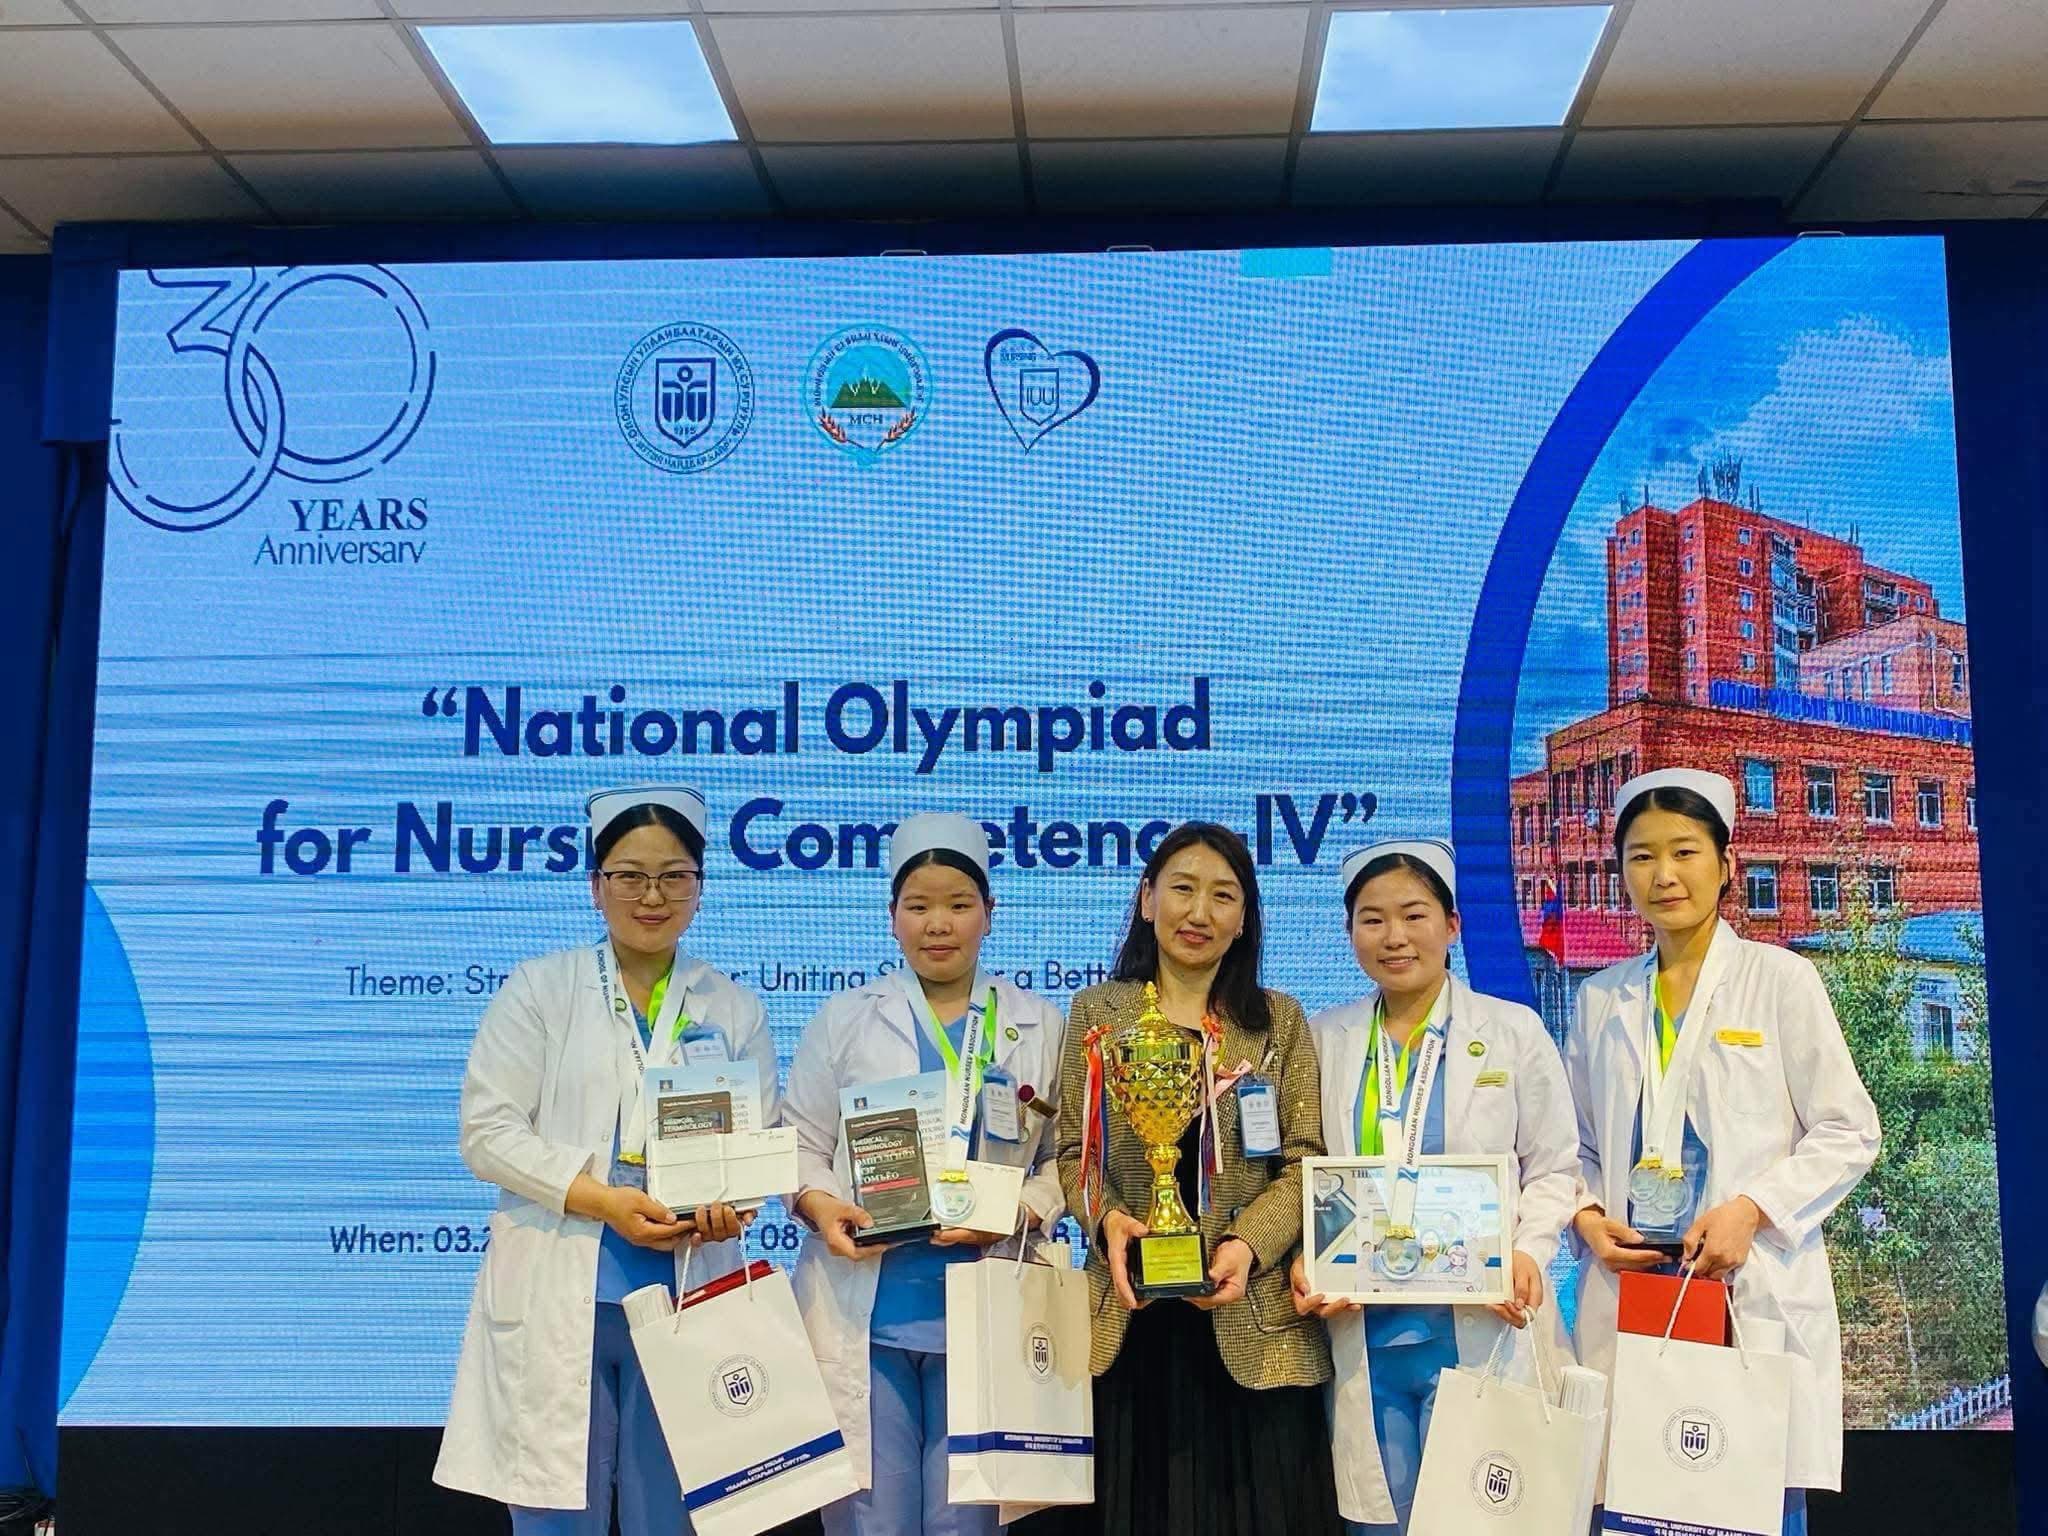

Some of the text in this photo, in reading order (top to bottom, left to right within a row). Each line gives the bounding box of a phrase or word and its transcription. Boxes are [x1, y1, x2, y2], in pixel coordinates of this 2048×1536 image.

[288, 497, 428, 531] YEARS
[422, 677, 1211, 774] “National Olympiad
[256, 799, 372, 875] for
[345, 964, 453, 996] Theme:
[1014, 969, 1033, 990] a
[1044, 960, 1114, 990] Bett
[960, 1083, 971, 1125] MONGOLIAN
[1405, 1117, 1419, 1166] MONGOLIAN
[1420, 1039, 1437, 1085] ASSOCIATION
[330, 1223, 425, 1254] When:
